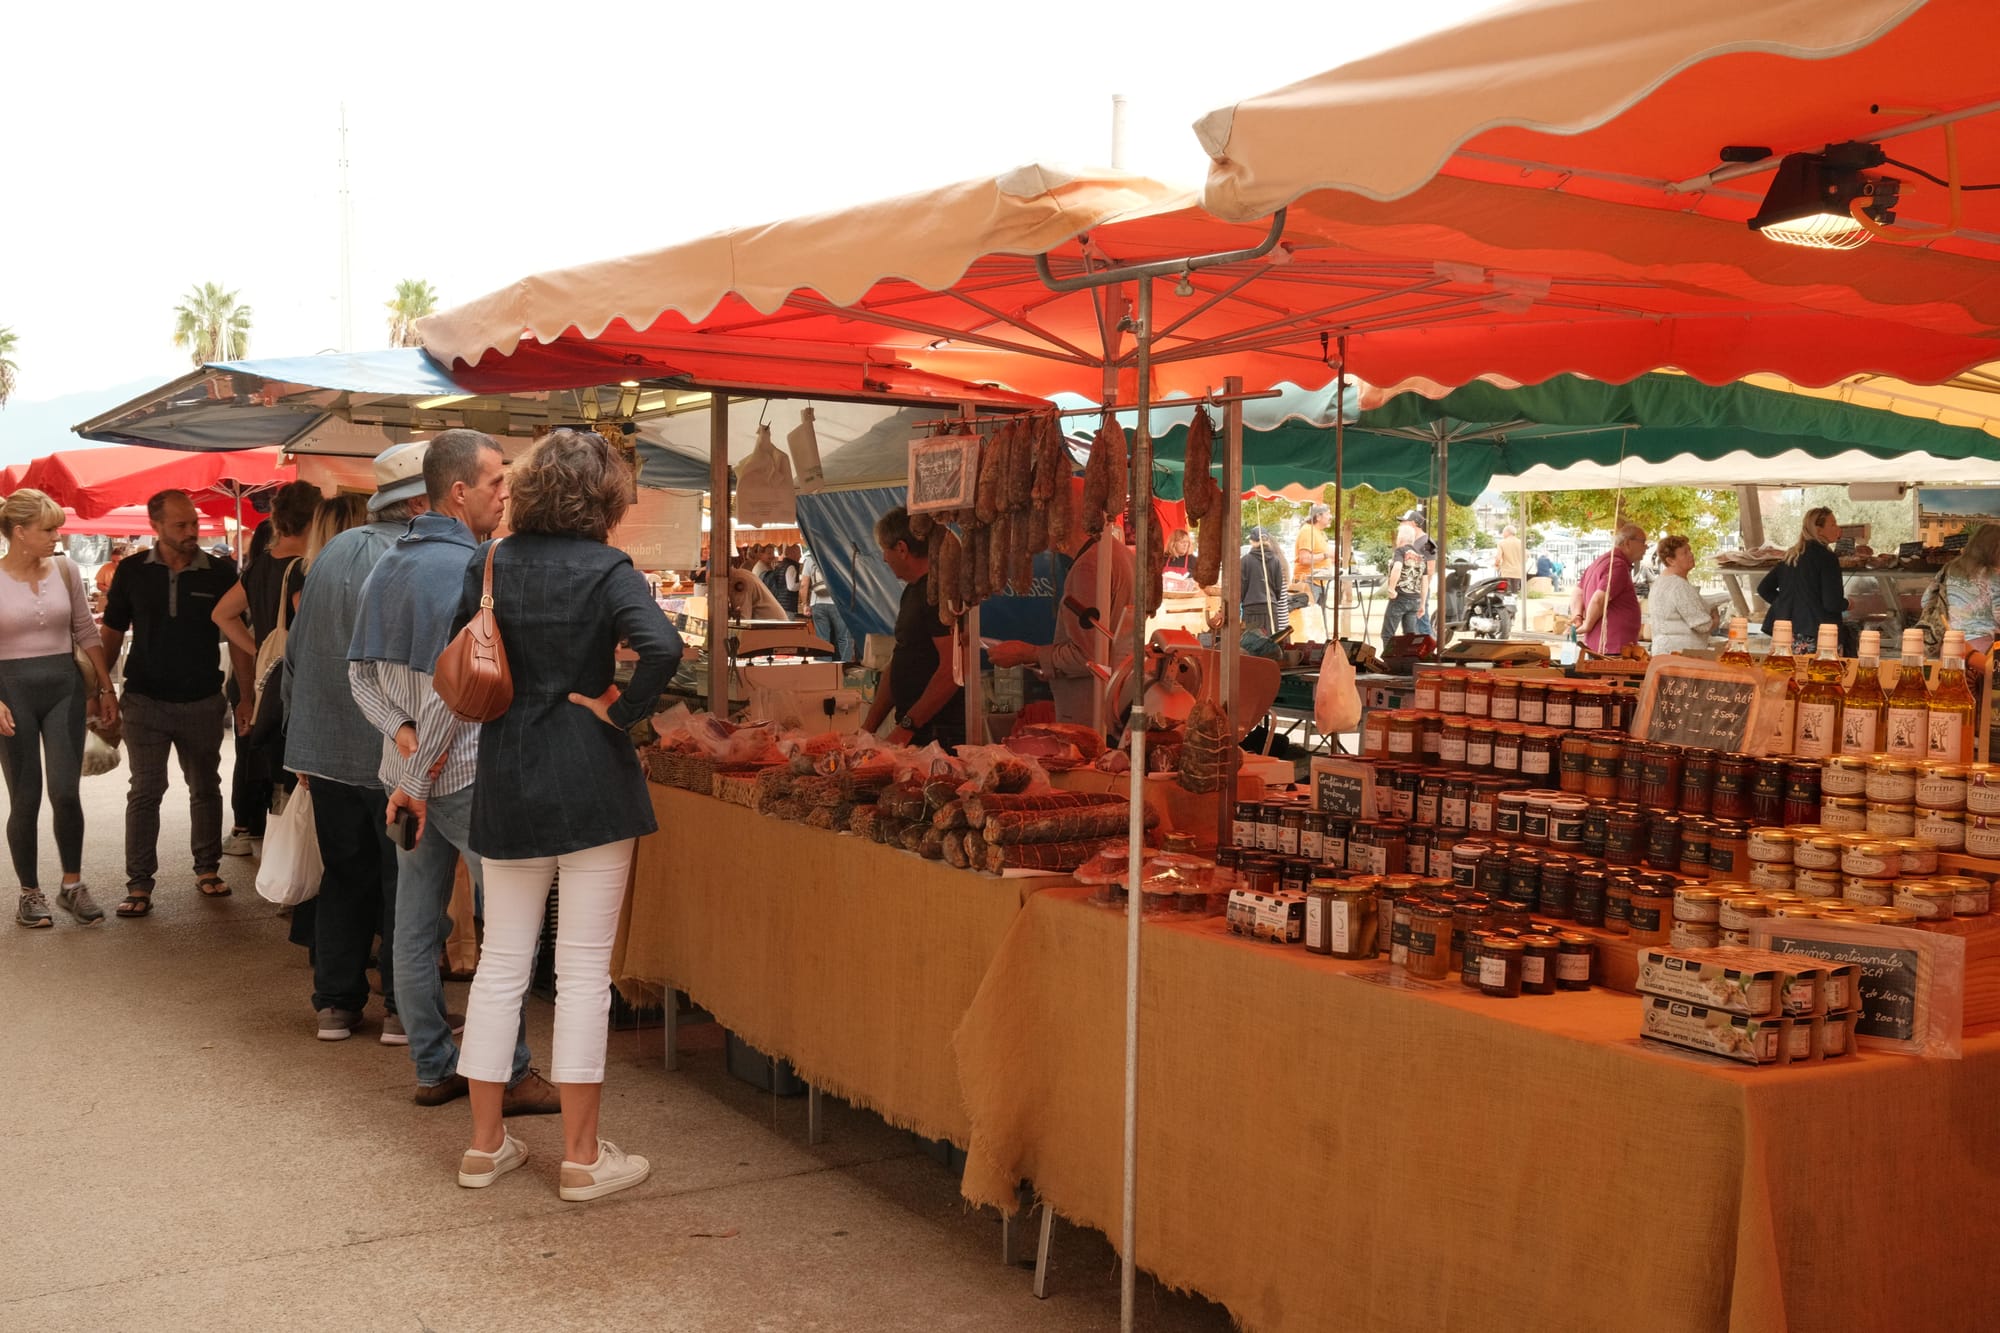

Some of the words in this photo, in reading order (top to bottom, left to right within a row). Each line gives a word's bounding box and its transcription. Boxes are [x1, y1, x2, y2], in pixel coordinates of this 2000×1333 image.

[1688, 686, 1699, 699] de
[1919, 783, 1956, 793] Terrine
[1919, 824, 1956, 835] Terrine
[1834, 948, 1904, 967] artisanales
[1859, 966, 1895, 979] SCA"
